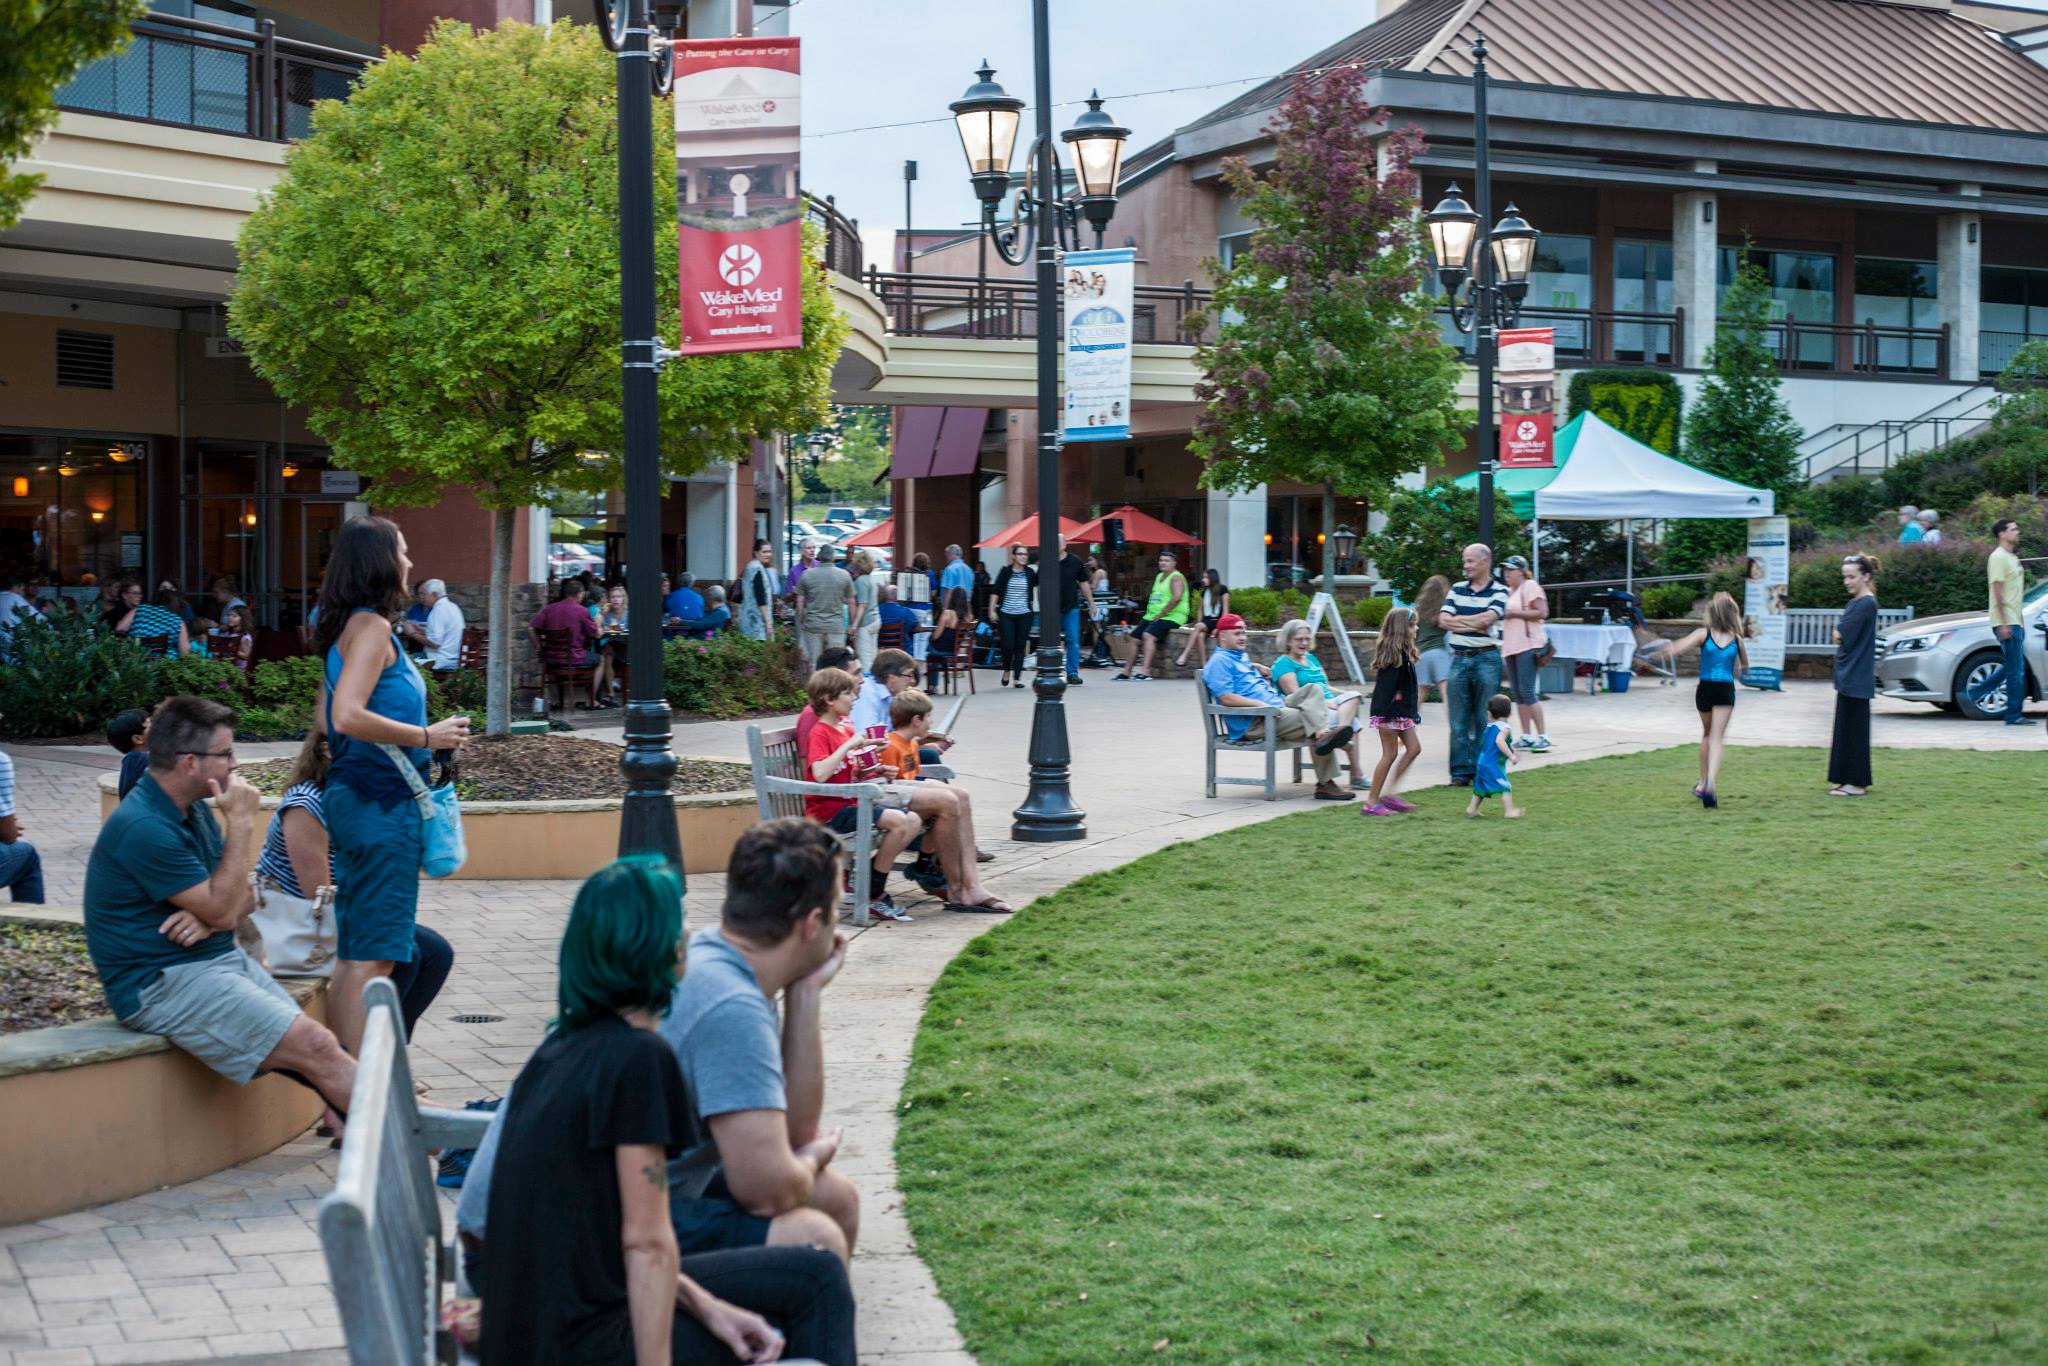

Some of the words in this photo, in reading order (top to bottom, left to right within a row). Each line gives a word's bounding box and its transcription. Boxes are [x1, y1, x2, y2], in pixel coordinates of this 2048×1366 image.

[686, 50, 717, 59] Putting
[718, 48, 732, 57] the
[734, 48, 755, 56] Care
[768, 47, 789, 56] Cary
[699, 288, 783, 306] WakeMed
[707, 306, 735, 318] Cary
[735, 303, 777, 316] Hospital
